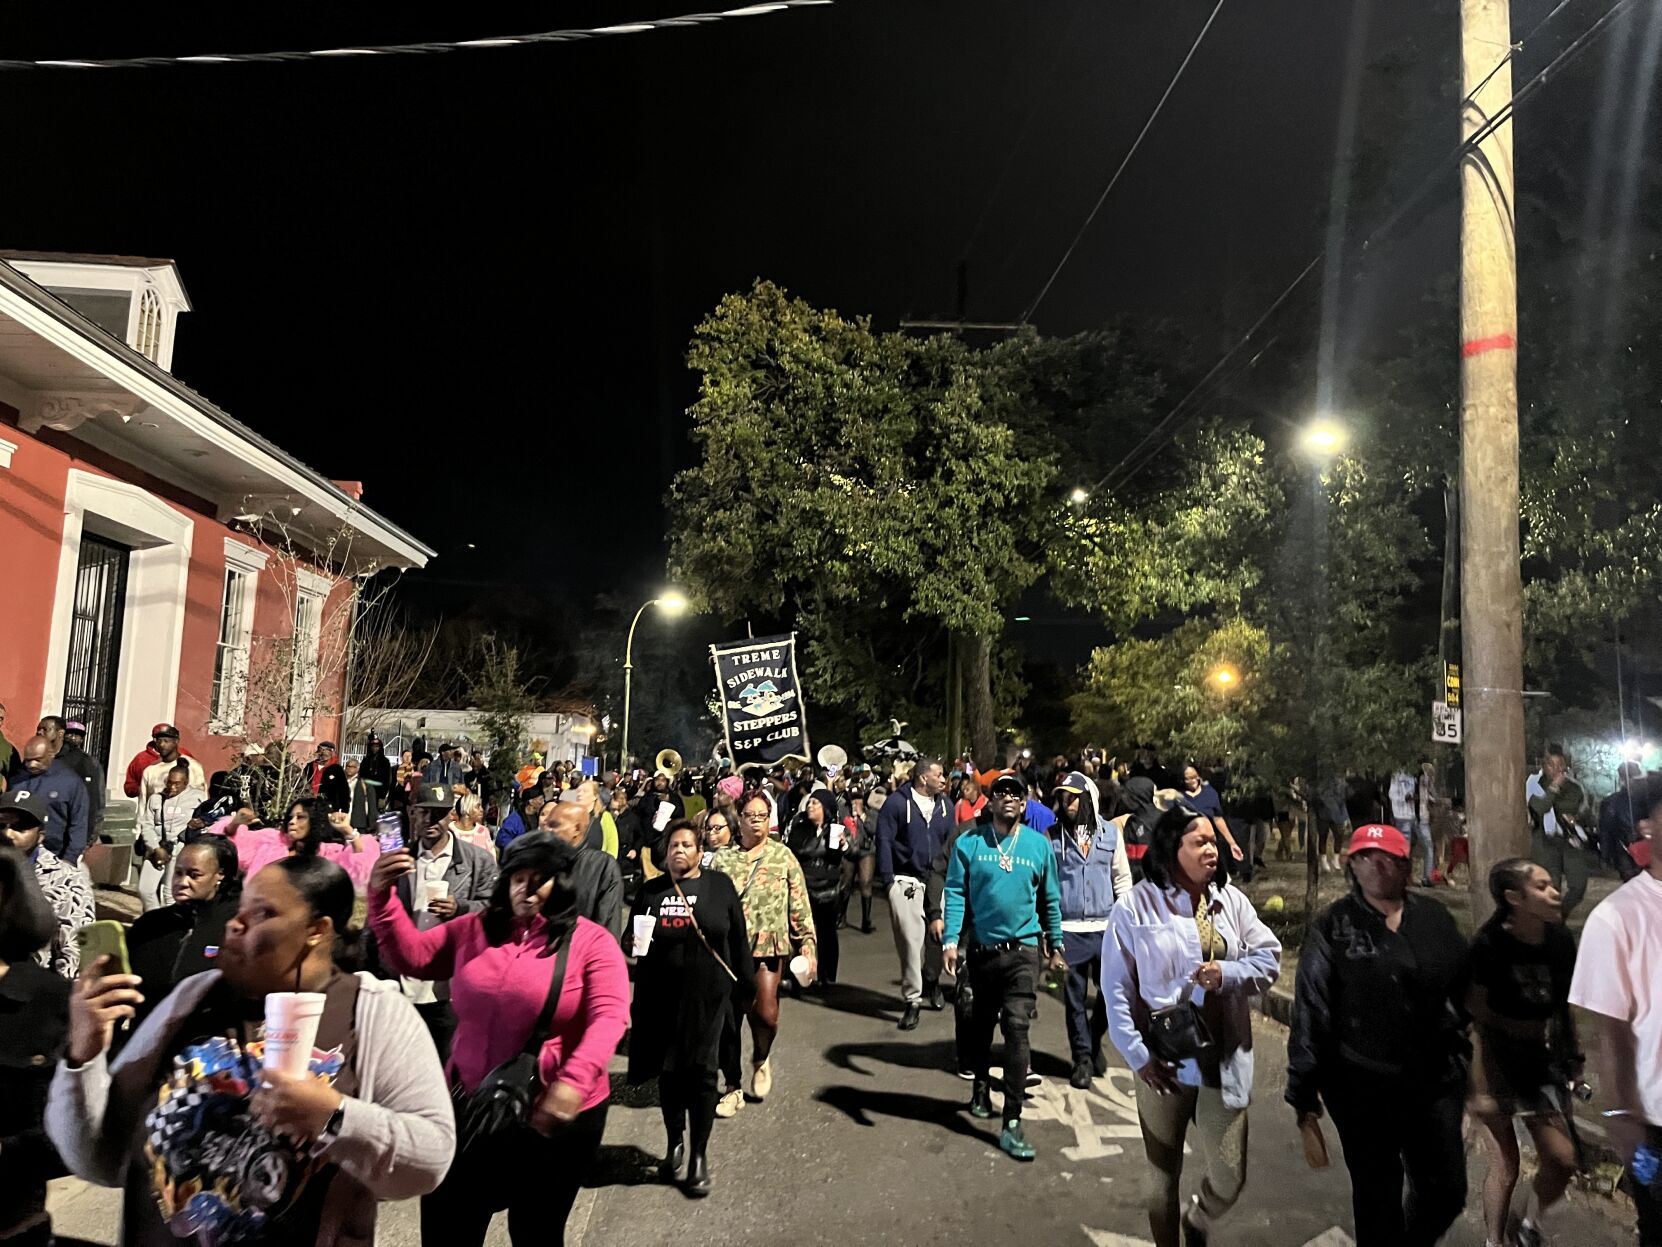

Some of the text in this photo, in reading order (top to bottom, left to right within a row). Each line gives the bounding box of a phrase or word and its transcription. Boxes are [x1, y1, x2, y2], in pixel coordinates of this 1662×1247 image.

[732, 649, 781, 666] TREME
[726, 667, 788, 689] SIDEWALK
[733, 711, 798, 732] STEPPERS
[766, 726, 800, 742] CLUB
[14, 790, 31, 803] P
